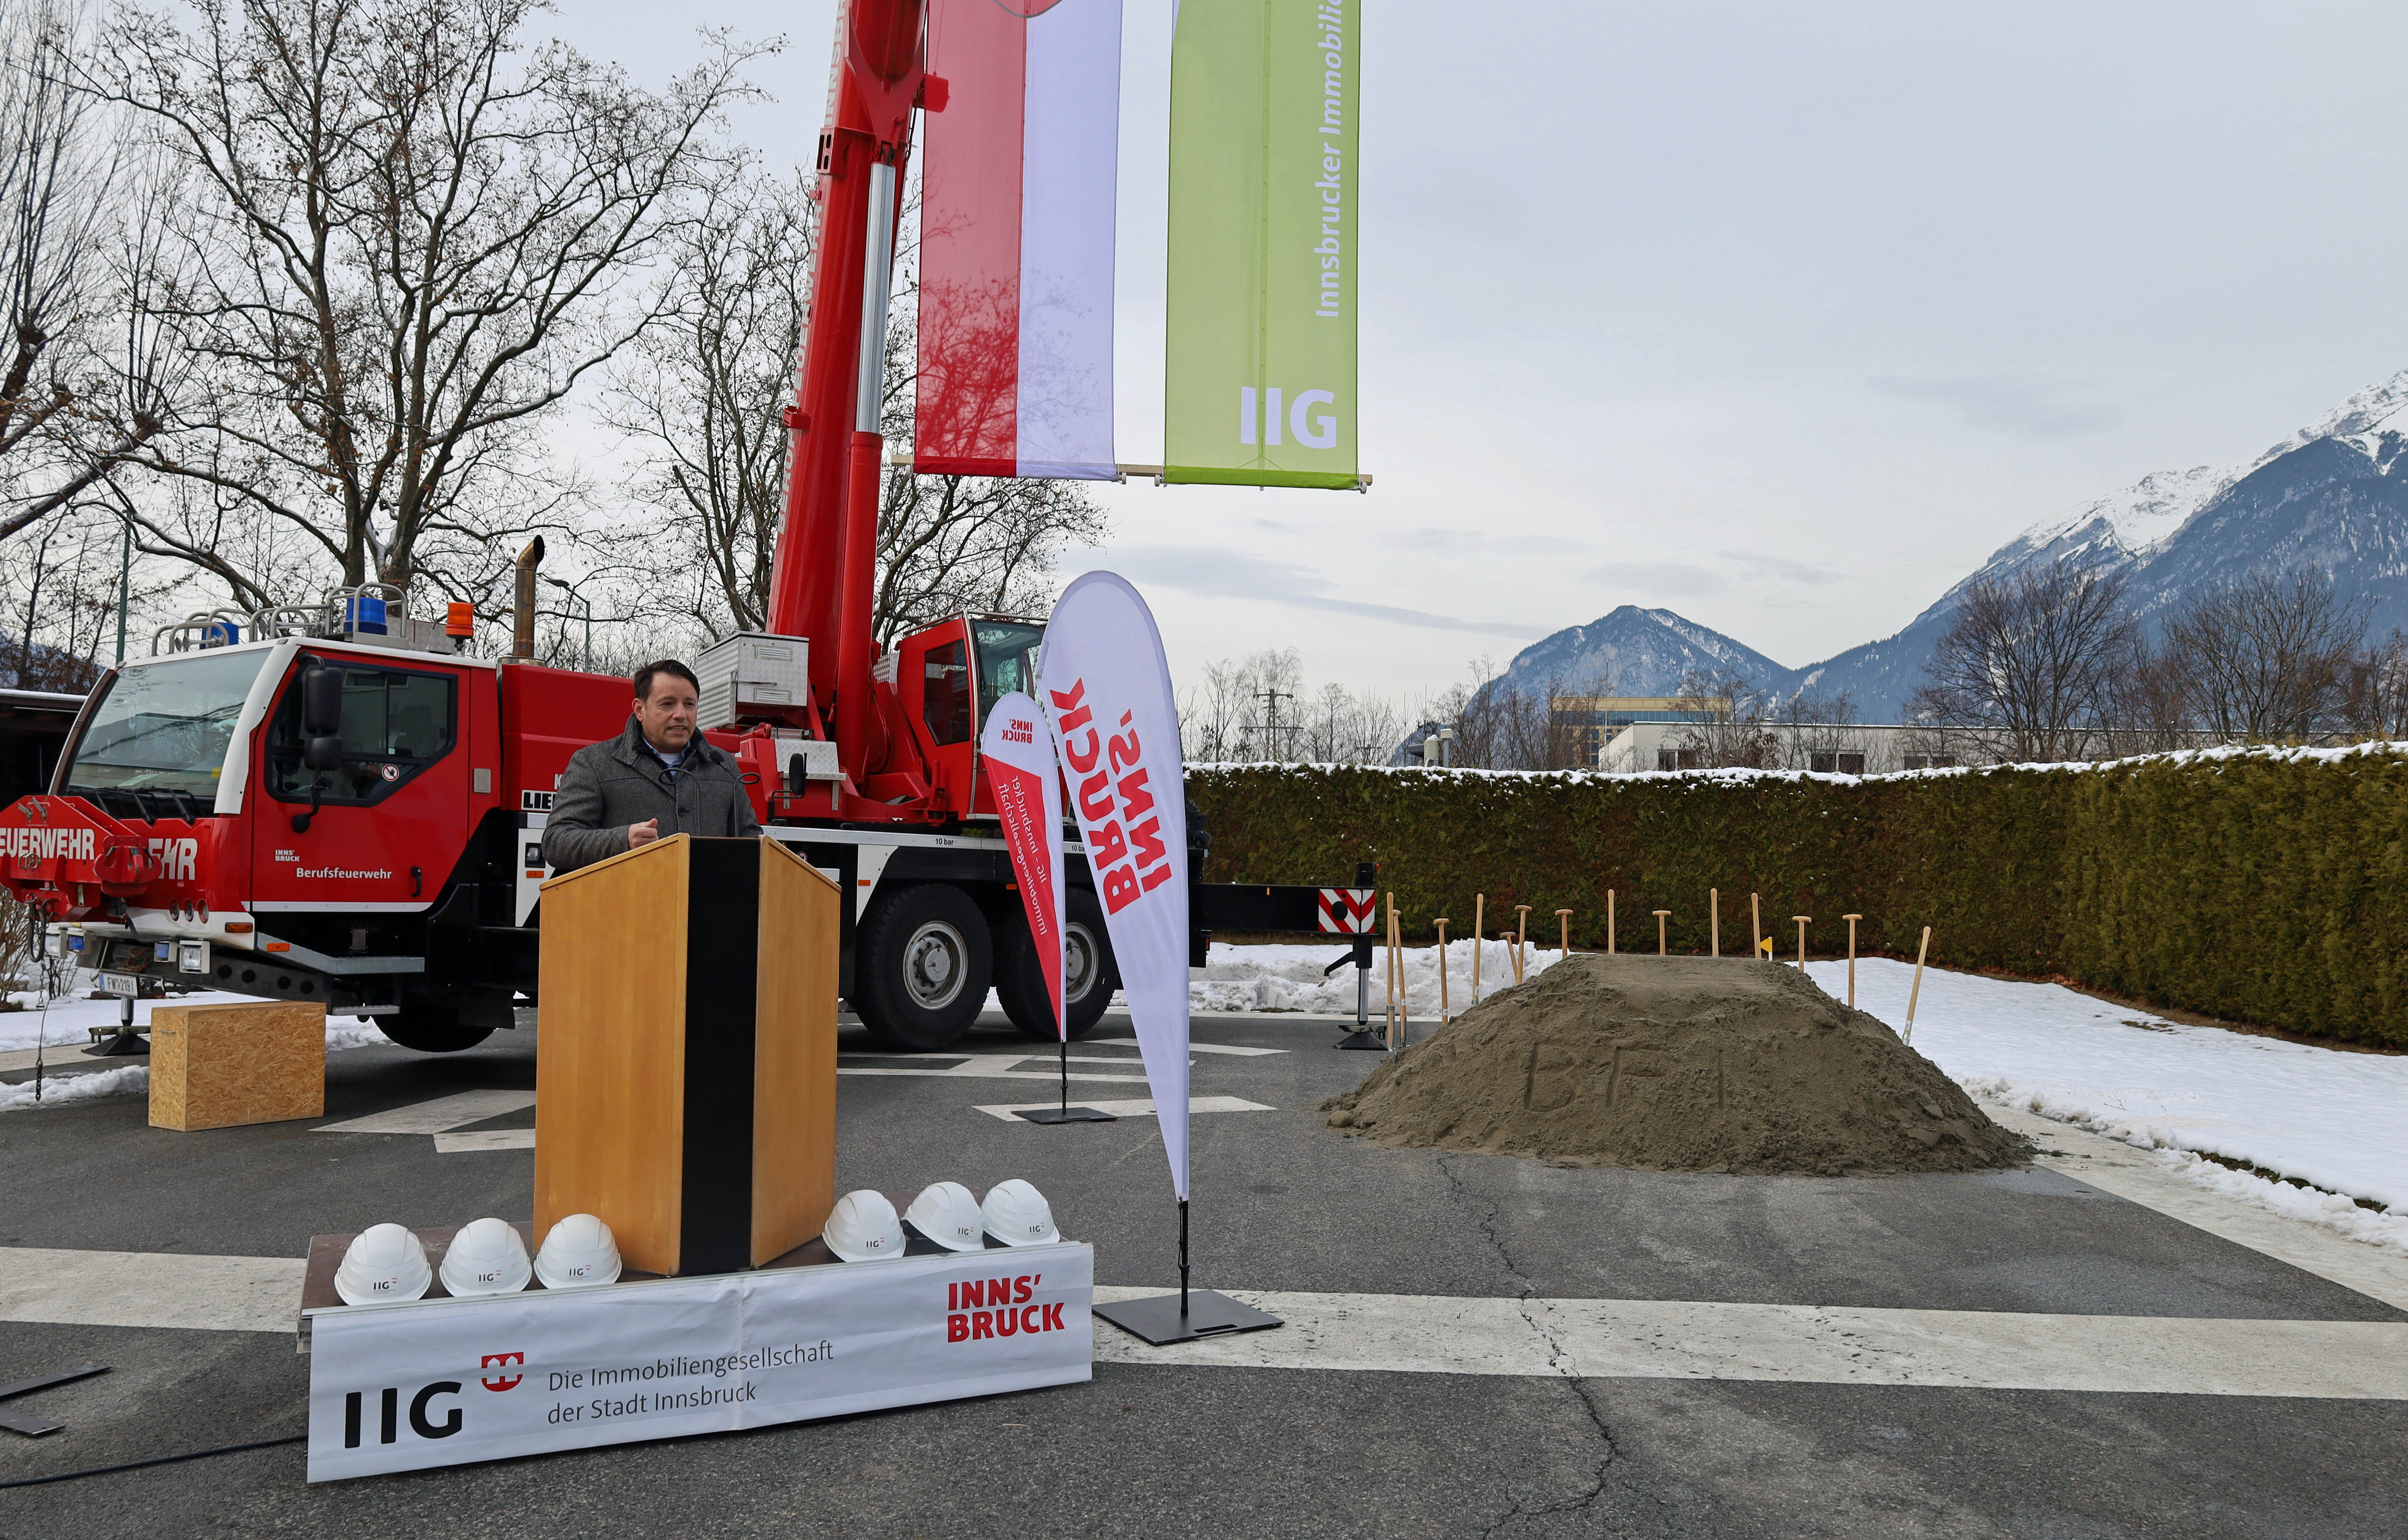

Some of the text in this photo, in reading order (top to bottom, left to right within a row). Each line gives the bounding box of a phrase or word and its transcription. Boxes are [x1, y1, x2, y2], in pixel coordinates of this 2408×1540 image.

[1314, 142, 1341, 317] Innsbrucker
[1241, 387, 1336, 448] IIG
[296, 867, 392, 879] Berufsfeuerwehr
[373, 1281, 389, 1290] IIG
[479, 1273, 494, 1282] IIG
[948, 1274, 1041, 1310] INNS'
[948, 1303, 1065, 1343] BRUCK
[549, 1343, 834, 1392] Die Immobiliengesellschaft
[344, 1381, 463, 1449] IIG
[548, 1381, 756, 1424] der Stadt Innsbruck
